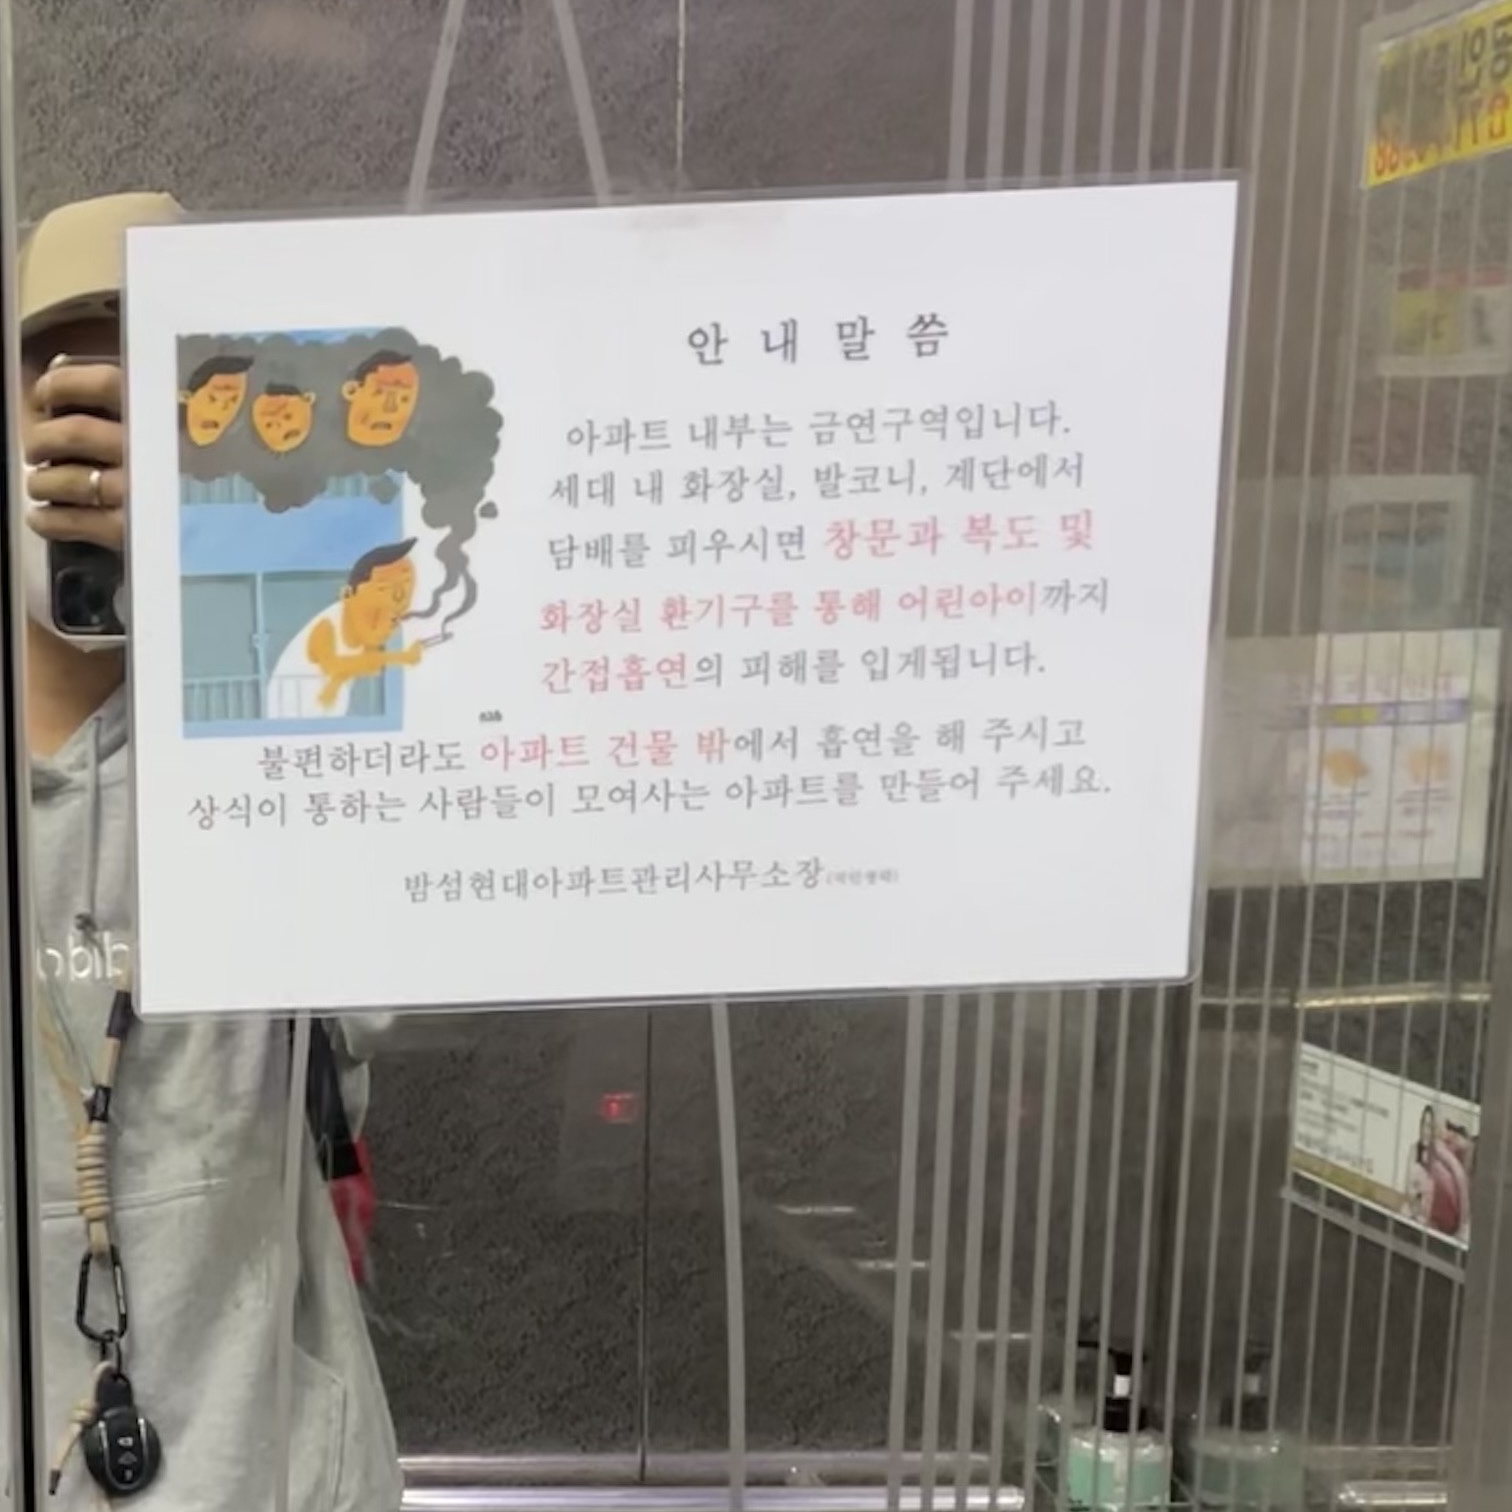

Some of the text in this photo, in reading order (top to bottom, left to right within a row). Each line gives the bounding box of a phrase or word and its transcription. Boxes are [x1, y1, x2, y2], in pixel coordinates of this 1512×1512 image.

[566, 400, 1070, 456] 아파트 내부는 금연구역입니다.
[551, 452, 1083, 508] 세대 내 화장실, 발코니, 계단에서
[548, 509, 1092, 571] 담배를 피우시면 창문과 복도 및
[540, 577, 1108, 635] 화장실 환기구를 통해 어린아이까지
[543, 640, 1045, 694] 간접흡연의 피해를 입게됩니다.
[258, 715, 1085, 781] 불편하더라도 아파트 건물 밖에서 흡연을 해 주시고
[188, 763, 1111, 831] 상식이 통하는 사람들이 모여사는 아파트를 만들어 주세요.
[404, 856, 824, 904] 밤섬현대아파트관리사무소장
